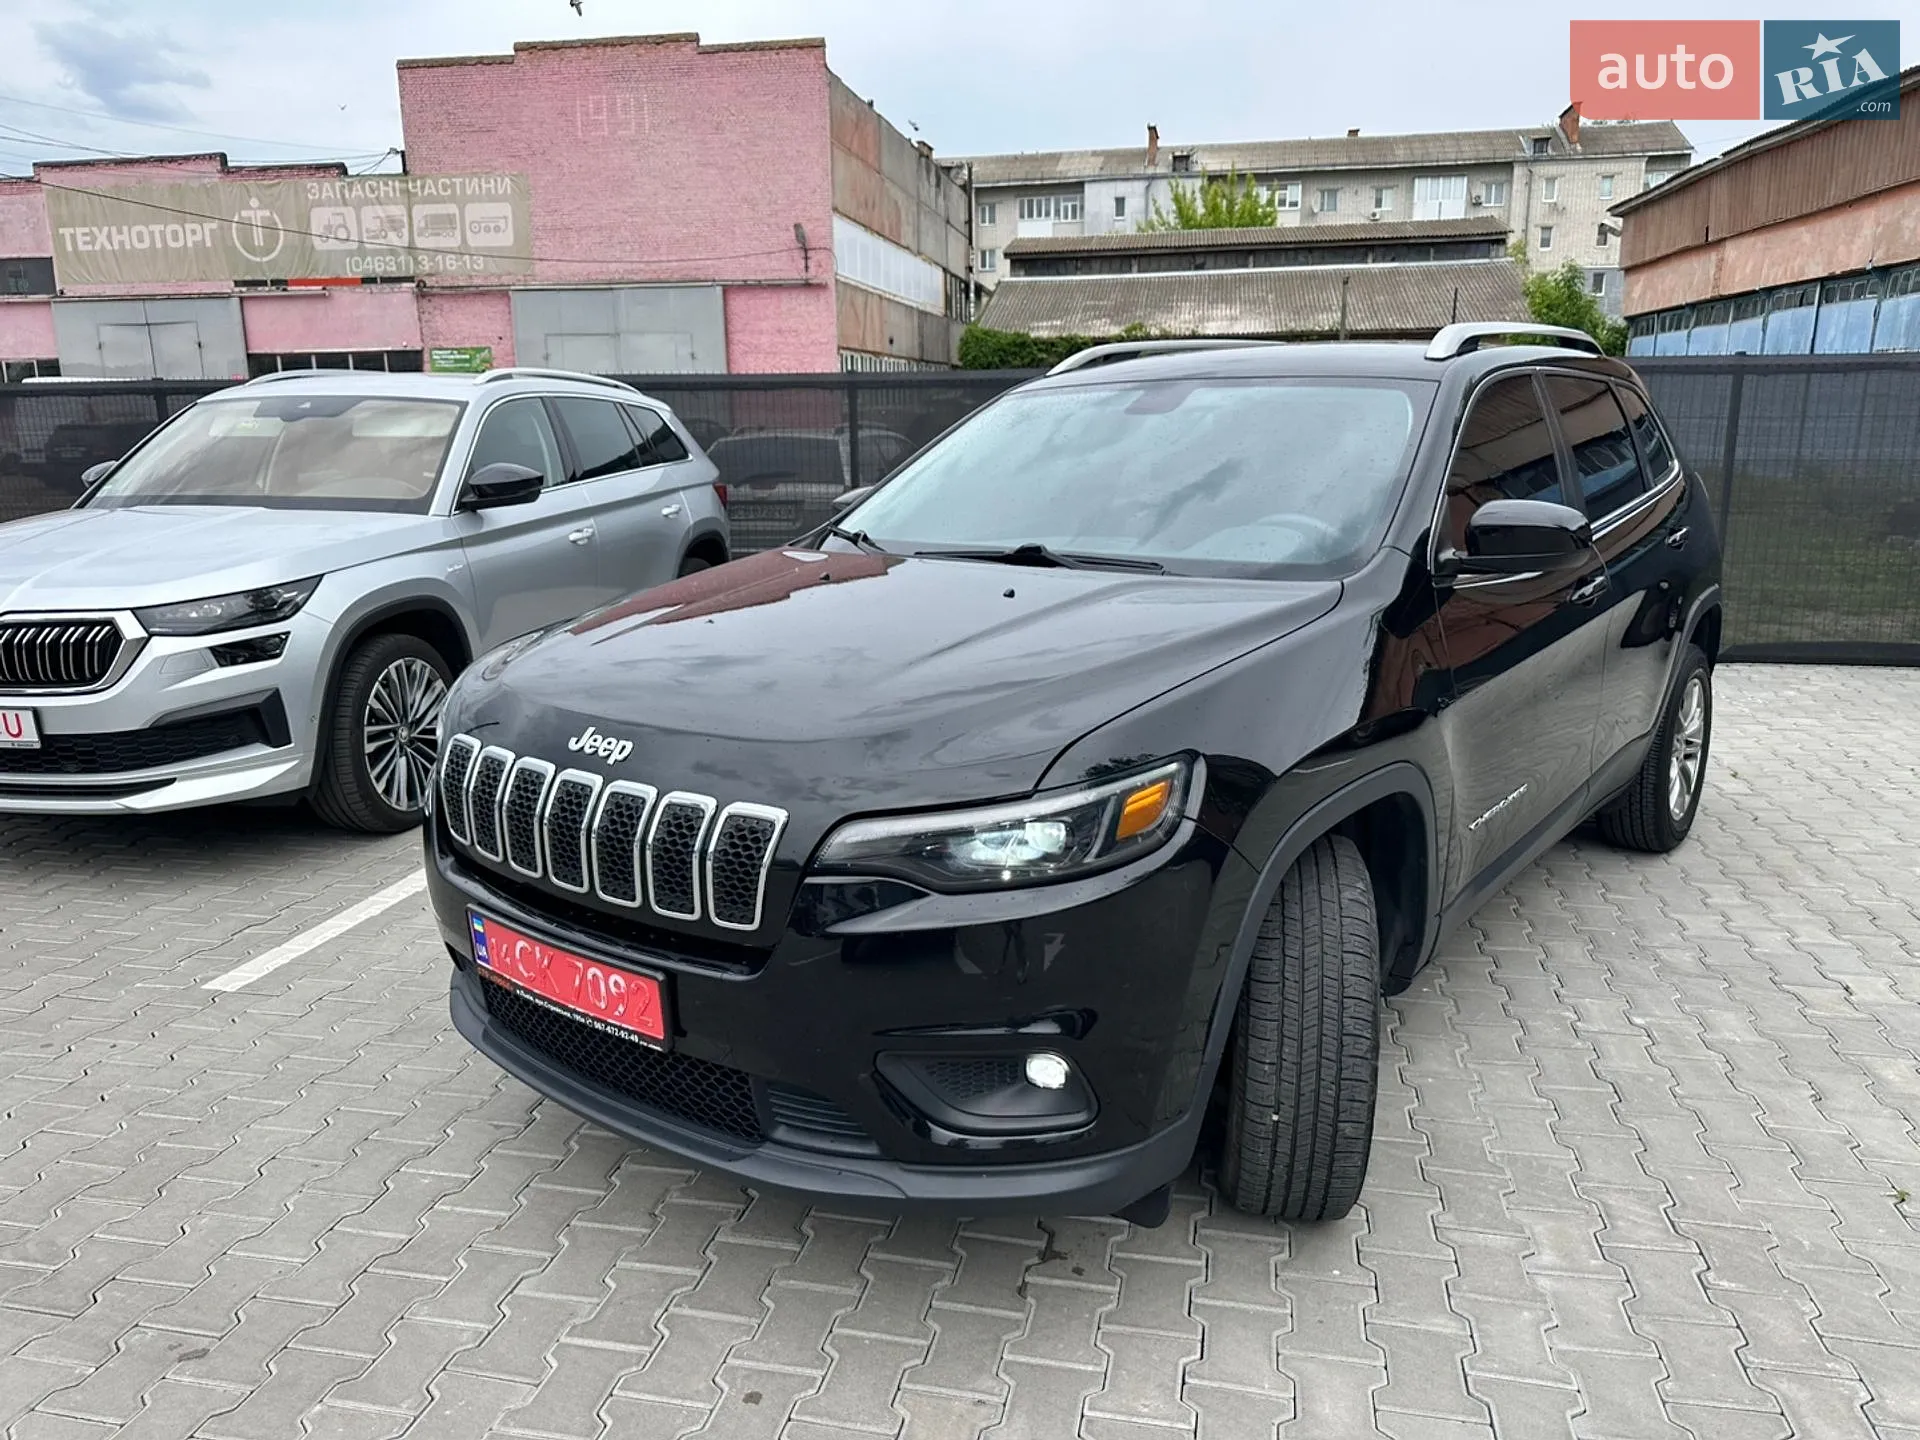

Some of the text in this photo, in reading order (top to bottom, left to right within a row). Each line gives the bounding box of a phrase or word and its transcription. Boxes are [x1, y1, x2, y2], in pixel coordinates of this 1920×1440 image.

[306, 176, 512, 201] ЗАПАСНІ ЧАСТИНИ
[58, 222, 218, 252] ТЕХНОТОРГ
[345, 254, 485, 275] (04631) 3-16-13
[0, 712, 23, 740] U
[568, 726, 634, 765] Jeep
[476, 943, 489, 959] UA
